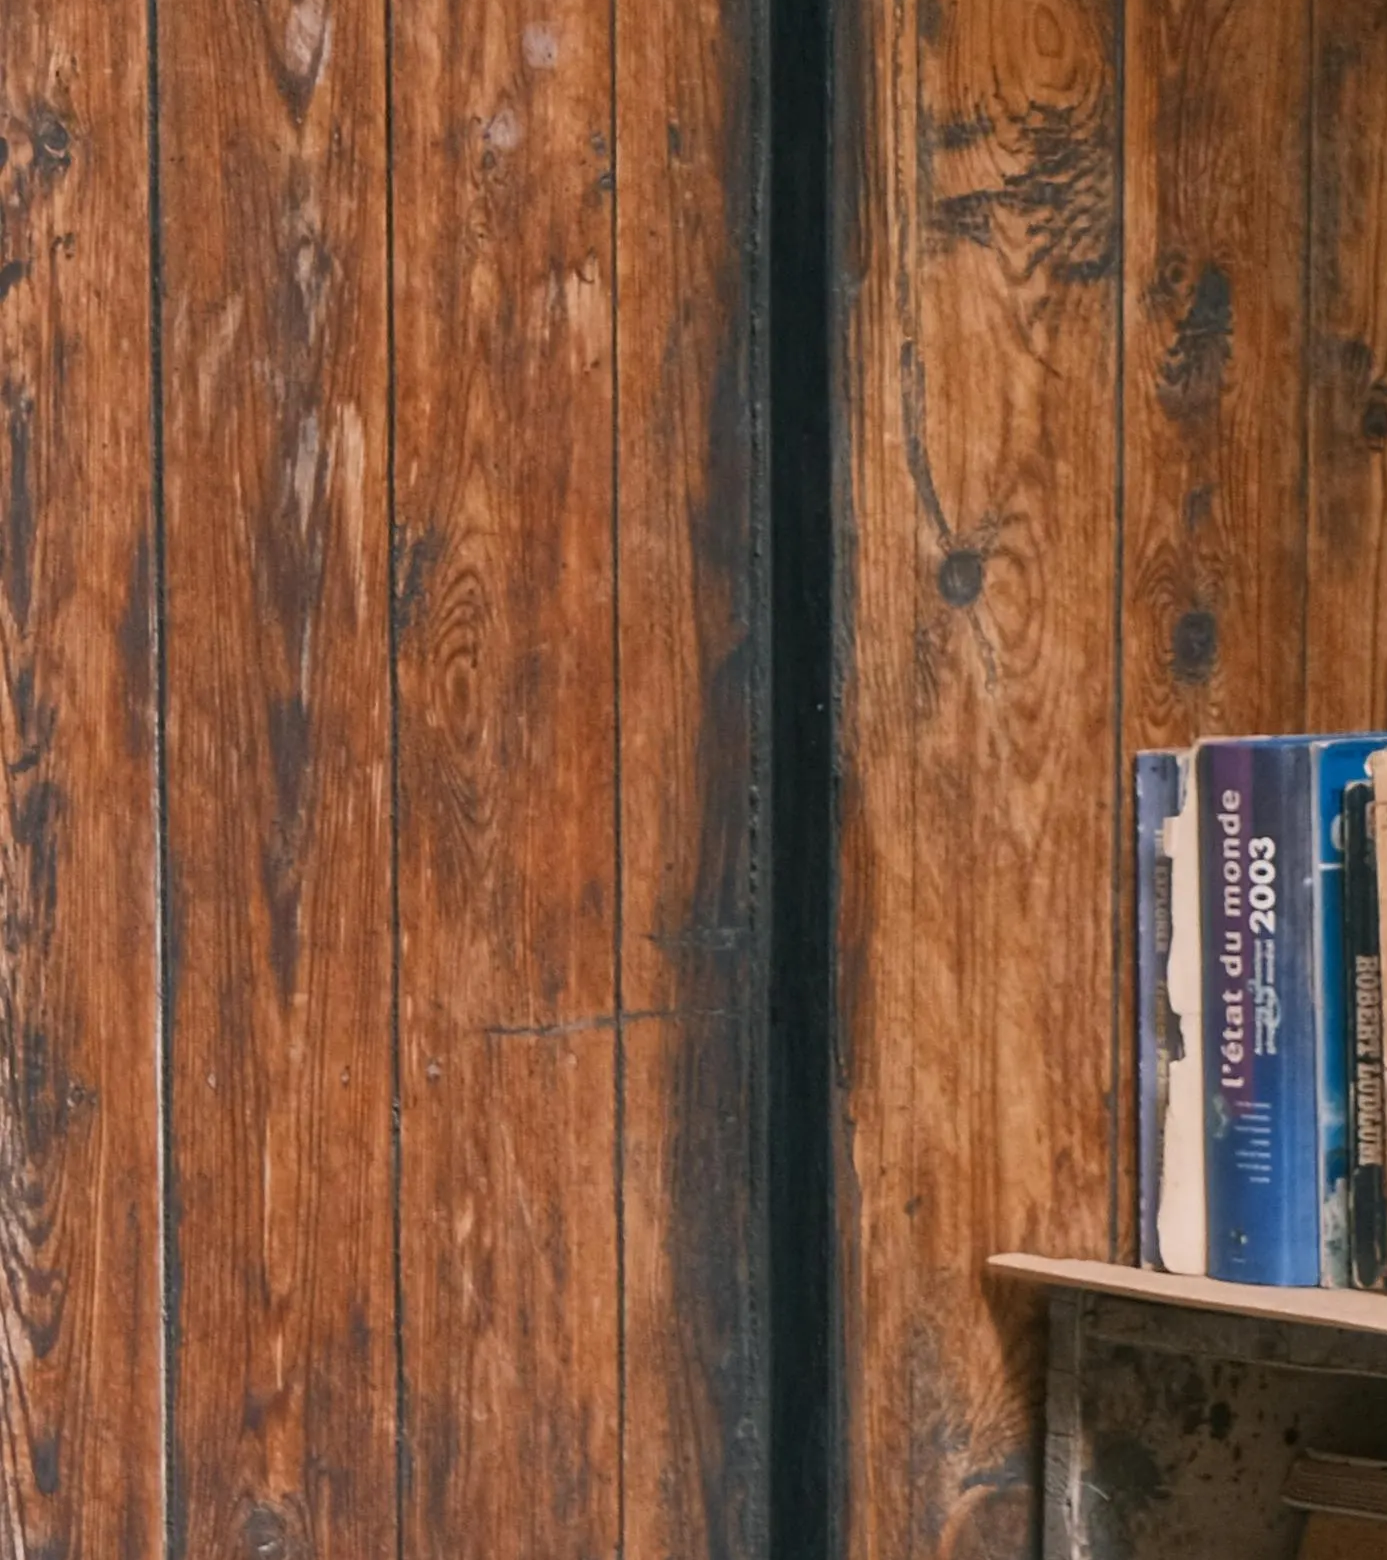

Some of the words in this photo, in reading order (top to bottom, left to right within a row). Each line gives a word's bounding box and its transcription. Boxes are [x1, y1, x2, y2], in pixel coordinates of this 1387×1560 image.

[1217, 790, 1243, 917] monde
[1249, 836, 1276, 934] 2003
[1218, 930, 1243, 977] du
[1356, 954, 1383, 1058] ROBERT
[1357, 1062, 1384, 1166] LUDLUM
